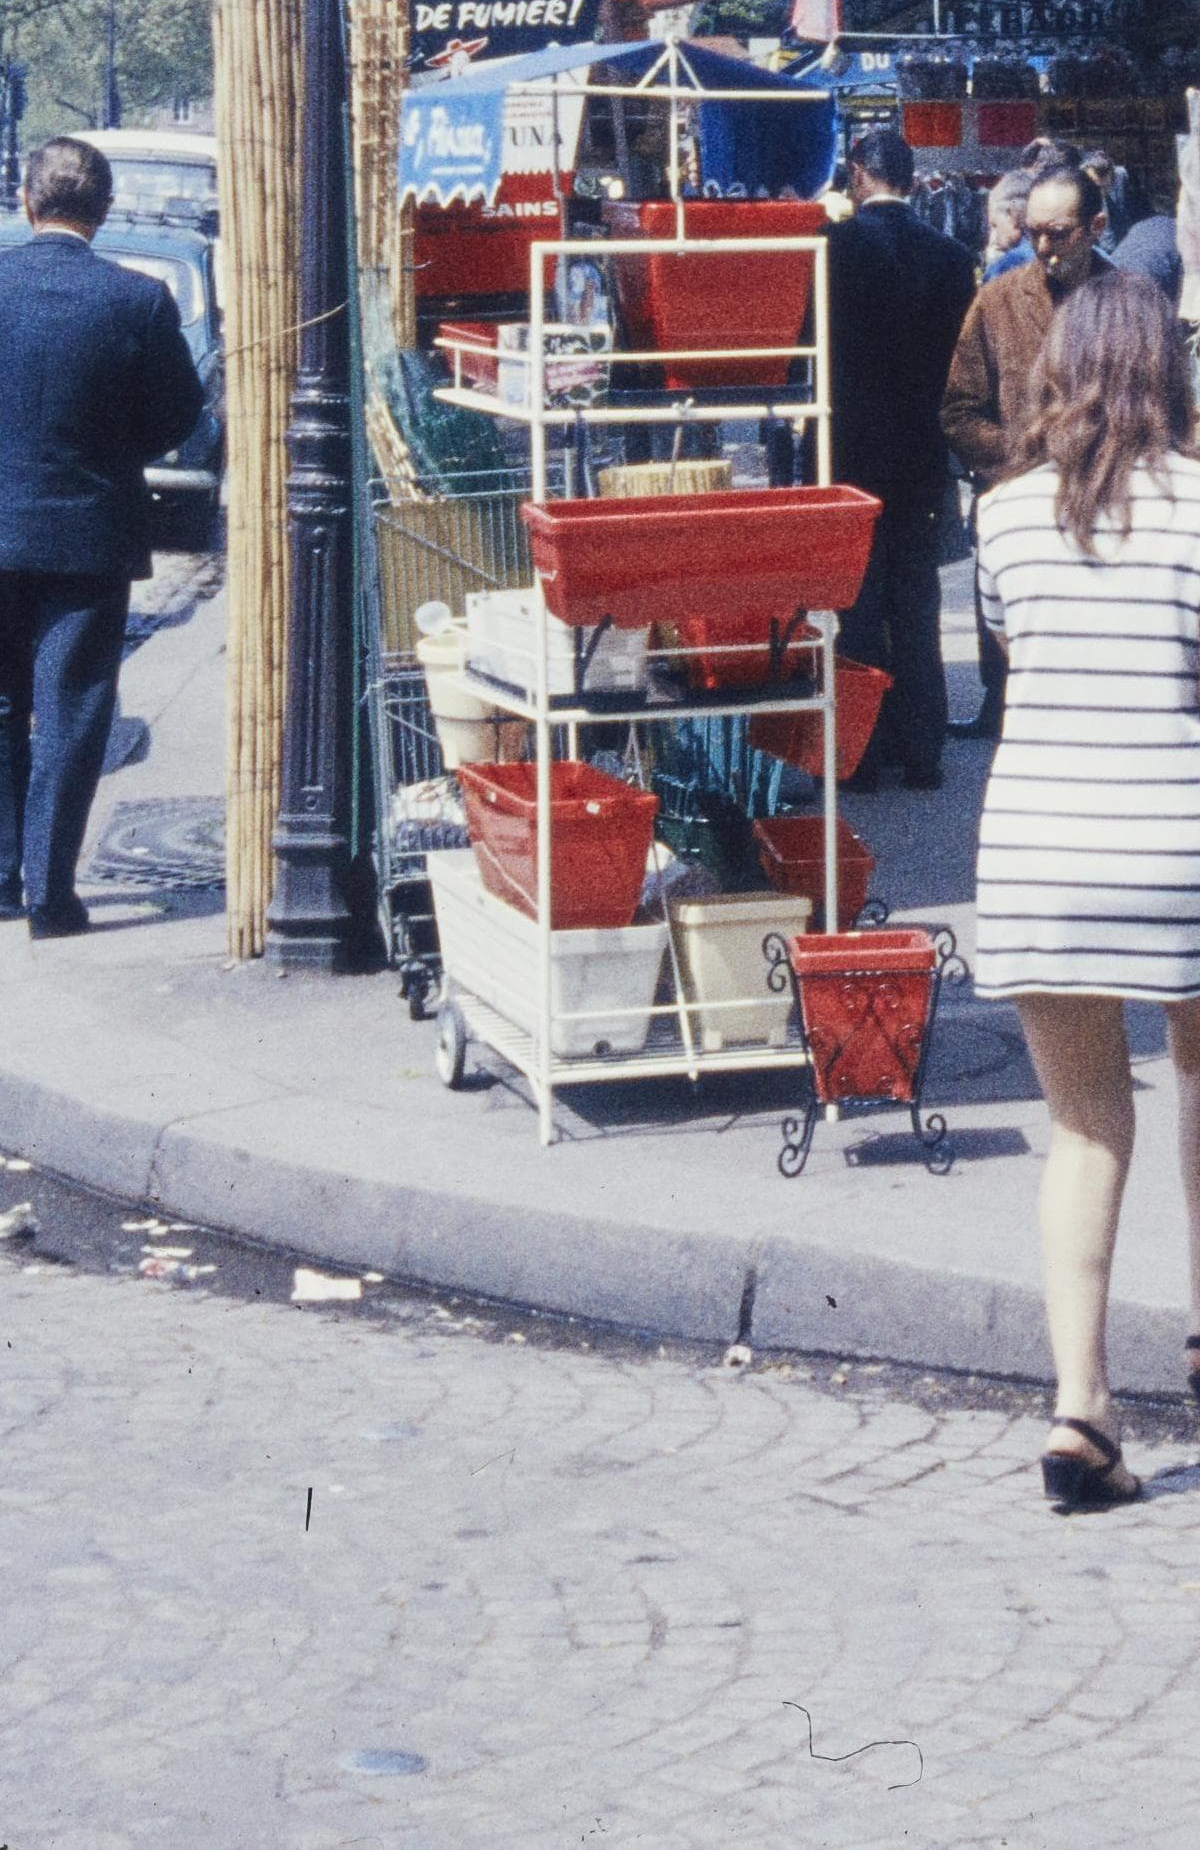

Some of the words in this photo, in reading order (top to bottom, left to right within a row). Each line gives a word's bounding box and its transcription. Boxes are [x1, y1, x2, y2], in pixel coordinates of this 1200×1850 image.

[415, 3, 453, 32] DE
[860, 52, 891, 72] DU
[505, 126, 565, 146] UNA
[481, 200, 559, 218] SAINS
